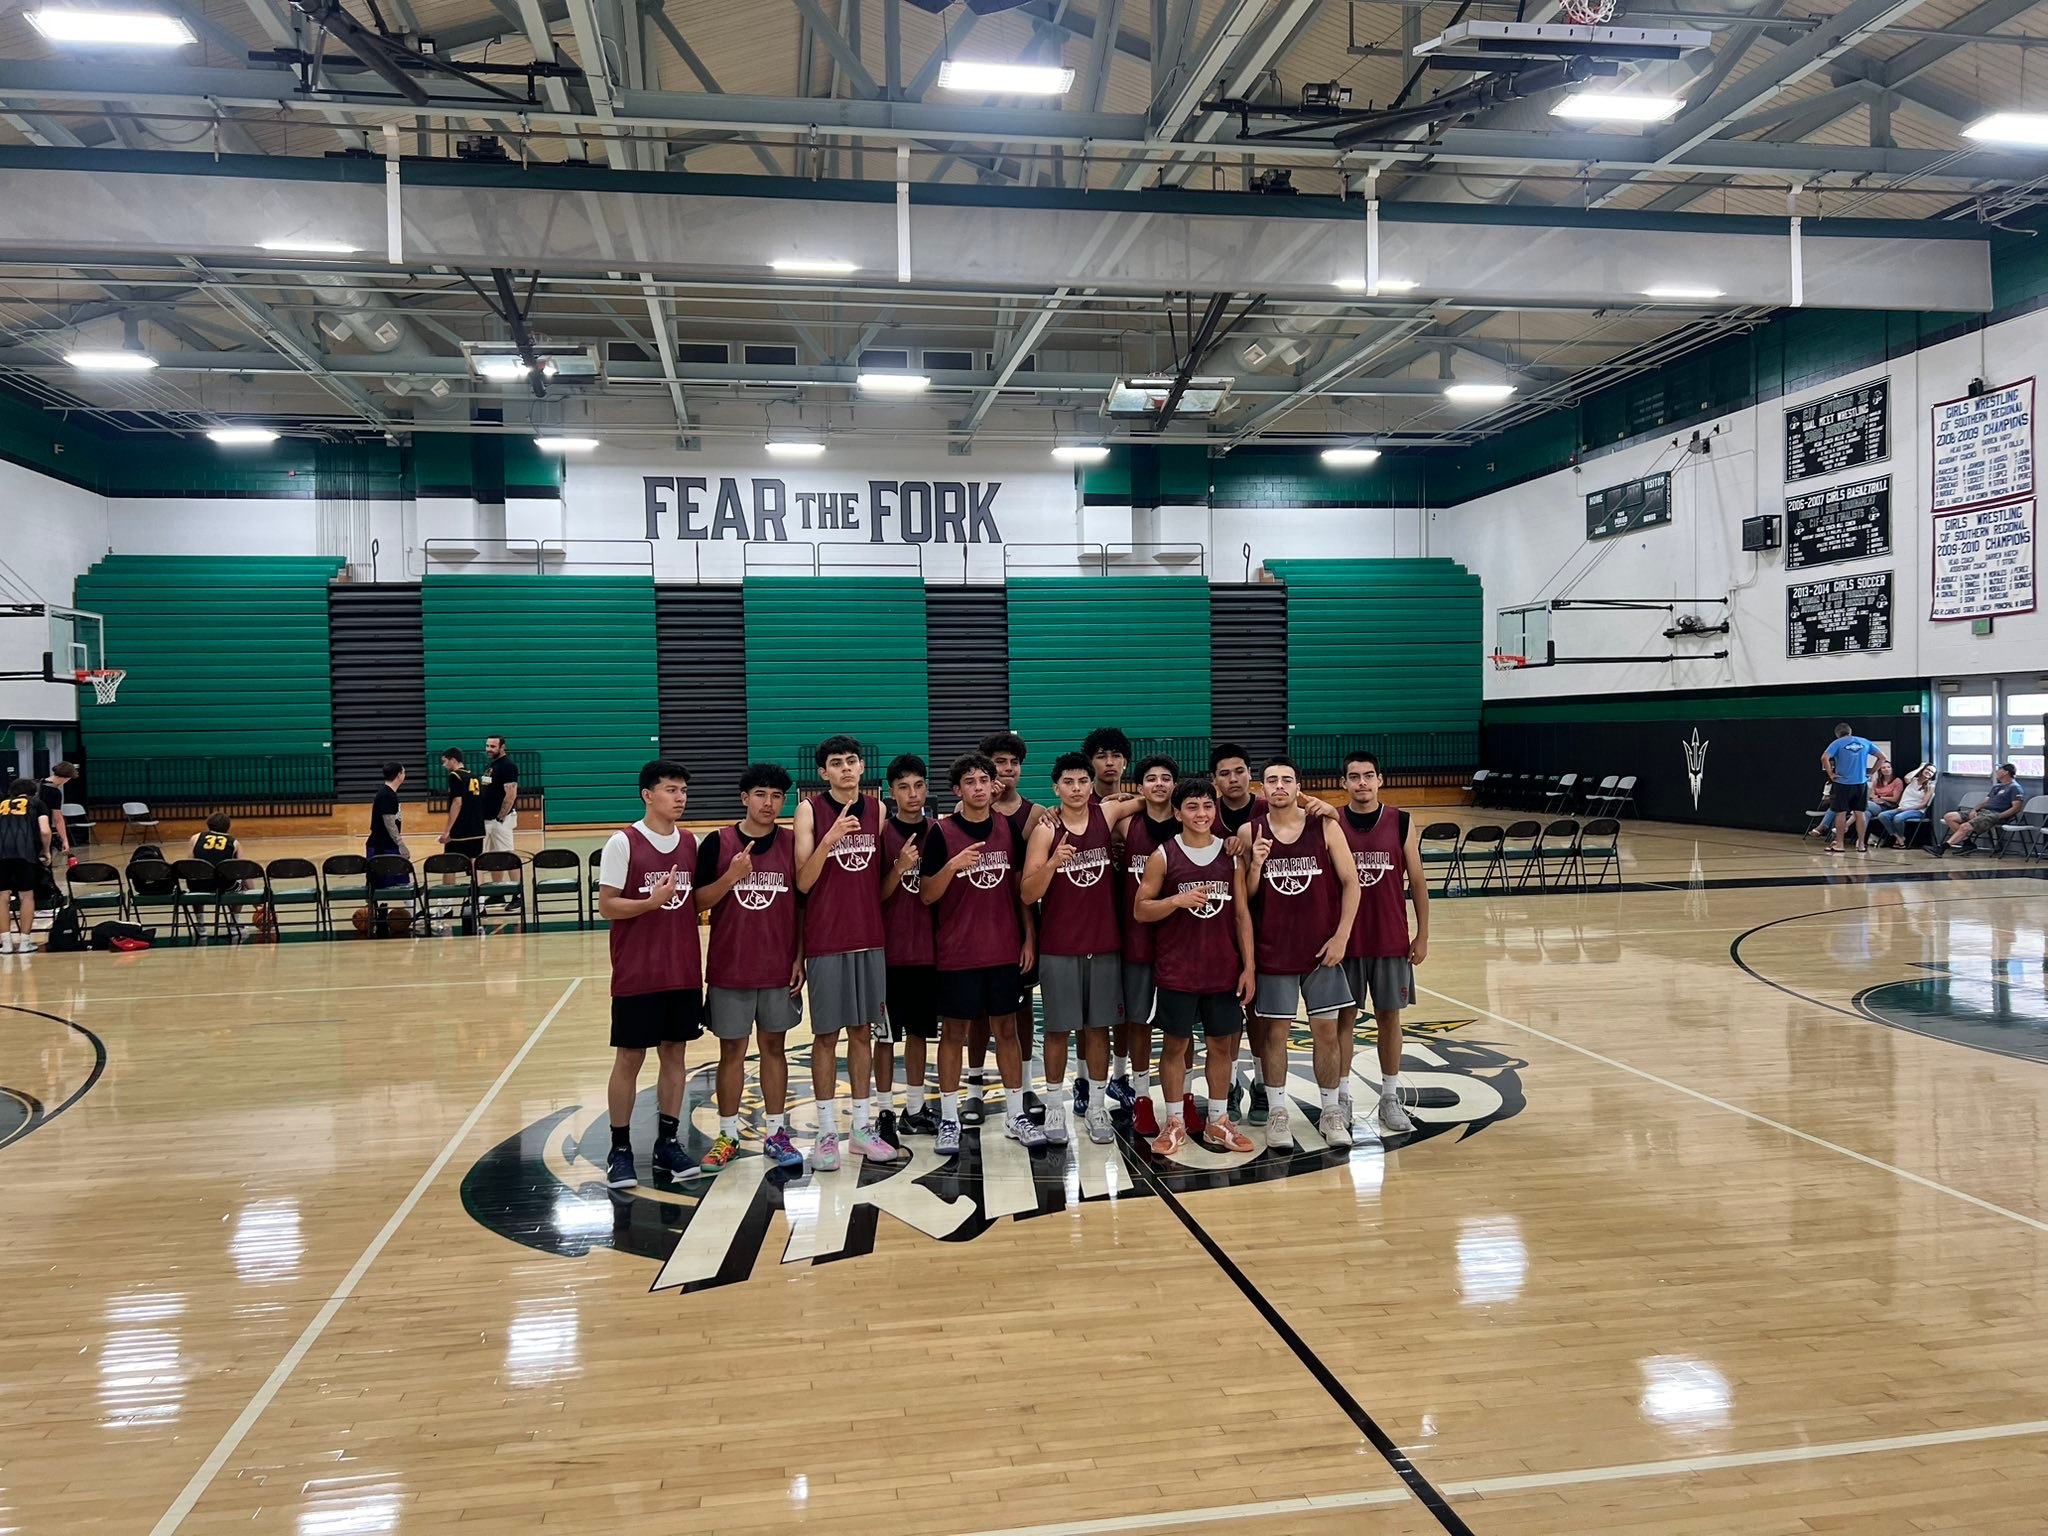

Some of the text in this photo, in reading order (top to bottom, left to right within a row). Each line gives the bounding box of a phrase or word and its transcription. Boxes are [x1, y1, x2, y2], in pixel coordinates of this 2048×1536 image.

[1947, 388, 2018, 418] GIRLS WRESTLING
[1838, 404, 1868, 421] WRESTLING
[1955, 411, 1987, 428] SOUTHERN
[1992, 402, 2022, 419] REGIONAL
[1984, 413, 2028, 435] CHAMPIONS
[1644, 476, 1665, 490] VISITOR
[1589, 494, 1603, 505] HOME
[1788, 480, 1887, 511] 2006-2007 GIRLS BASKETBALL
[643, 476, 1003, 543] FEAR THE FORK
[1945, 507, 2022, 530] GIRLS WRESTLING
[1955, 527, 1988, 541] SOUTHERN
[1994, 520, 2026, 534] REGIONAL
[1938, 532, 2030, 557] 2009-2010 CHAMPIONS
[1794, 576, 1885, 598] 2013-2014 GIRLS SOCCER
[469, 777, 480, 795] 43
[0, 798, 28, 816] 43
[203, 835, 228, 850] 33
[854, 834, 875, 848] PAULA
[986, 851, 1008, 866] PAULA
[1062, 847, 1108, 868] SANTA PAULA
[1265, 856, 1317, 872] SANTA PAULA
[1365, 851, 1390, 865] PAULA
[758, 871, 784, 886] PAULA
